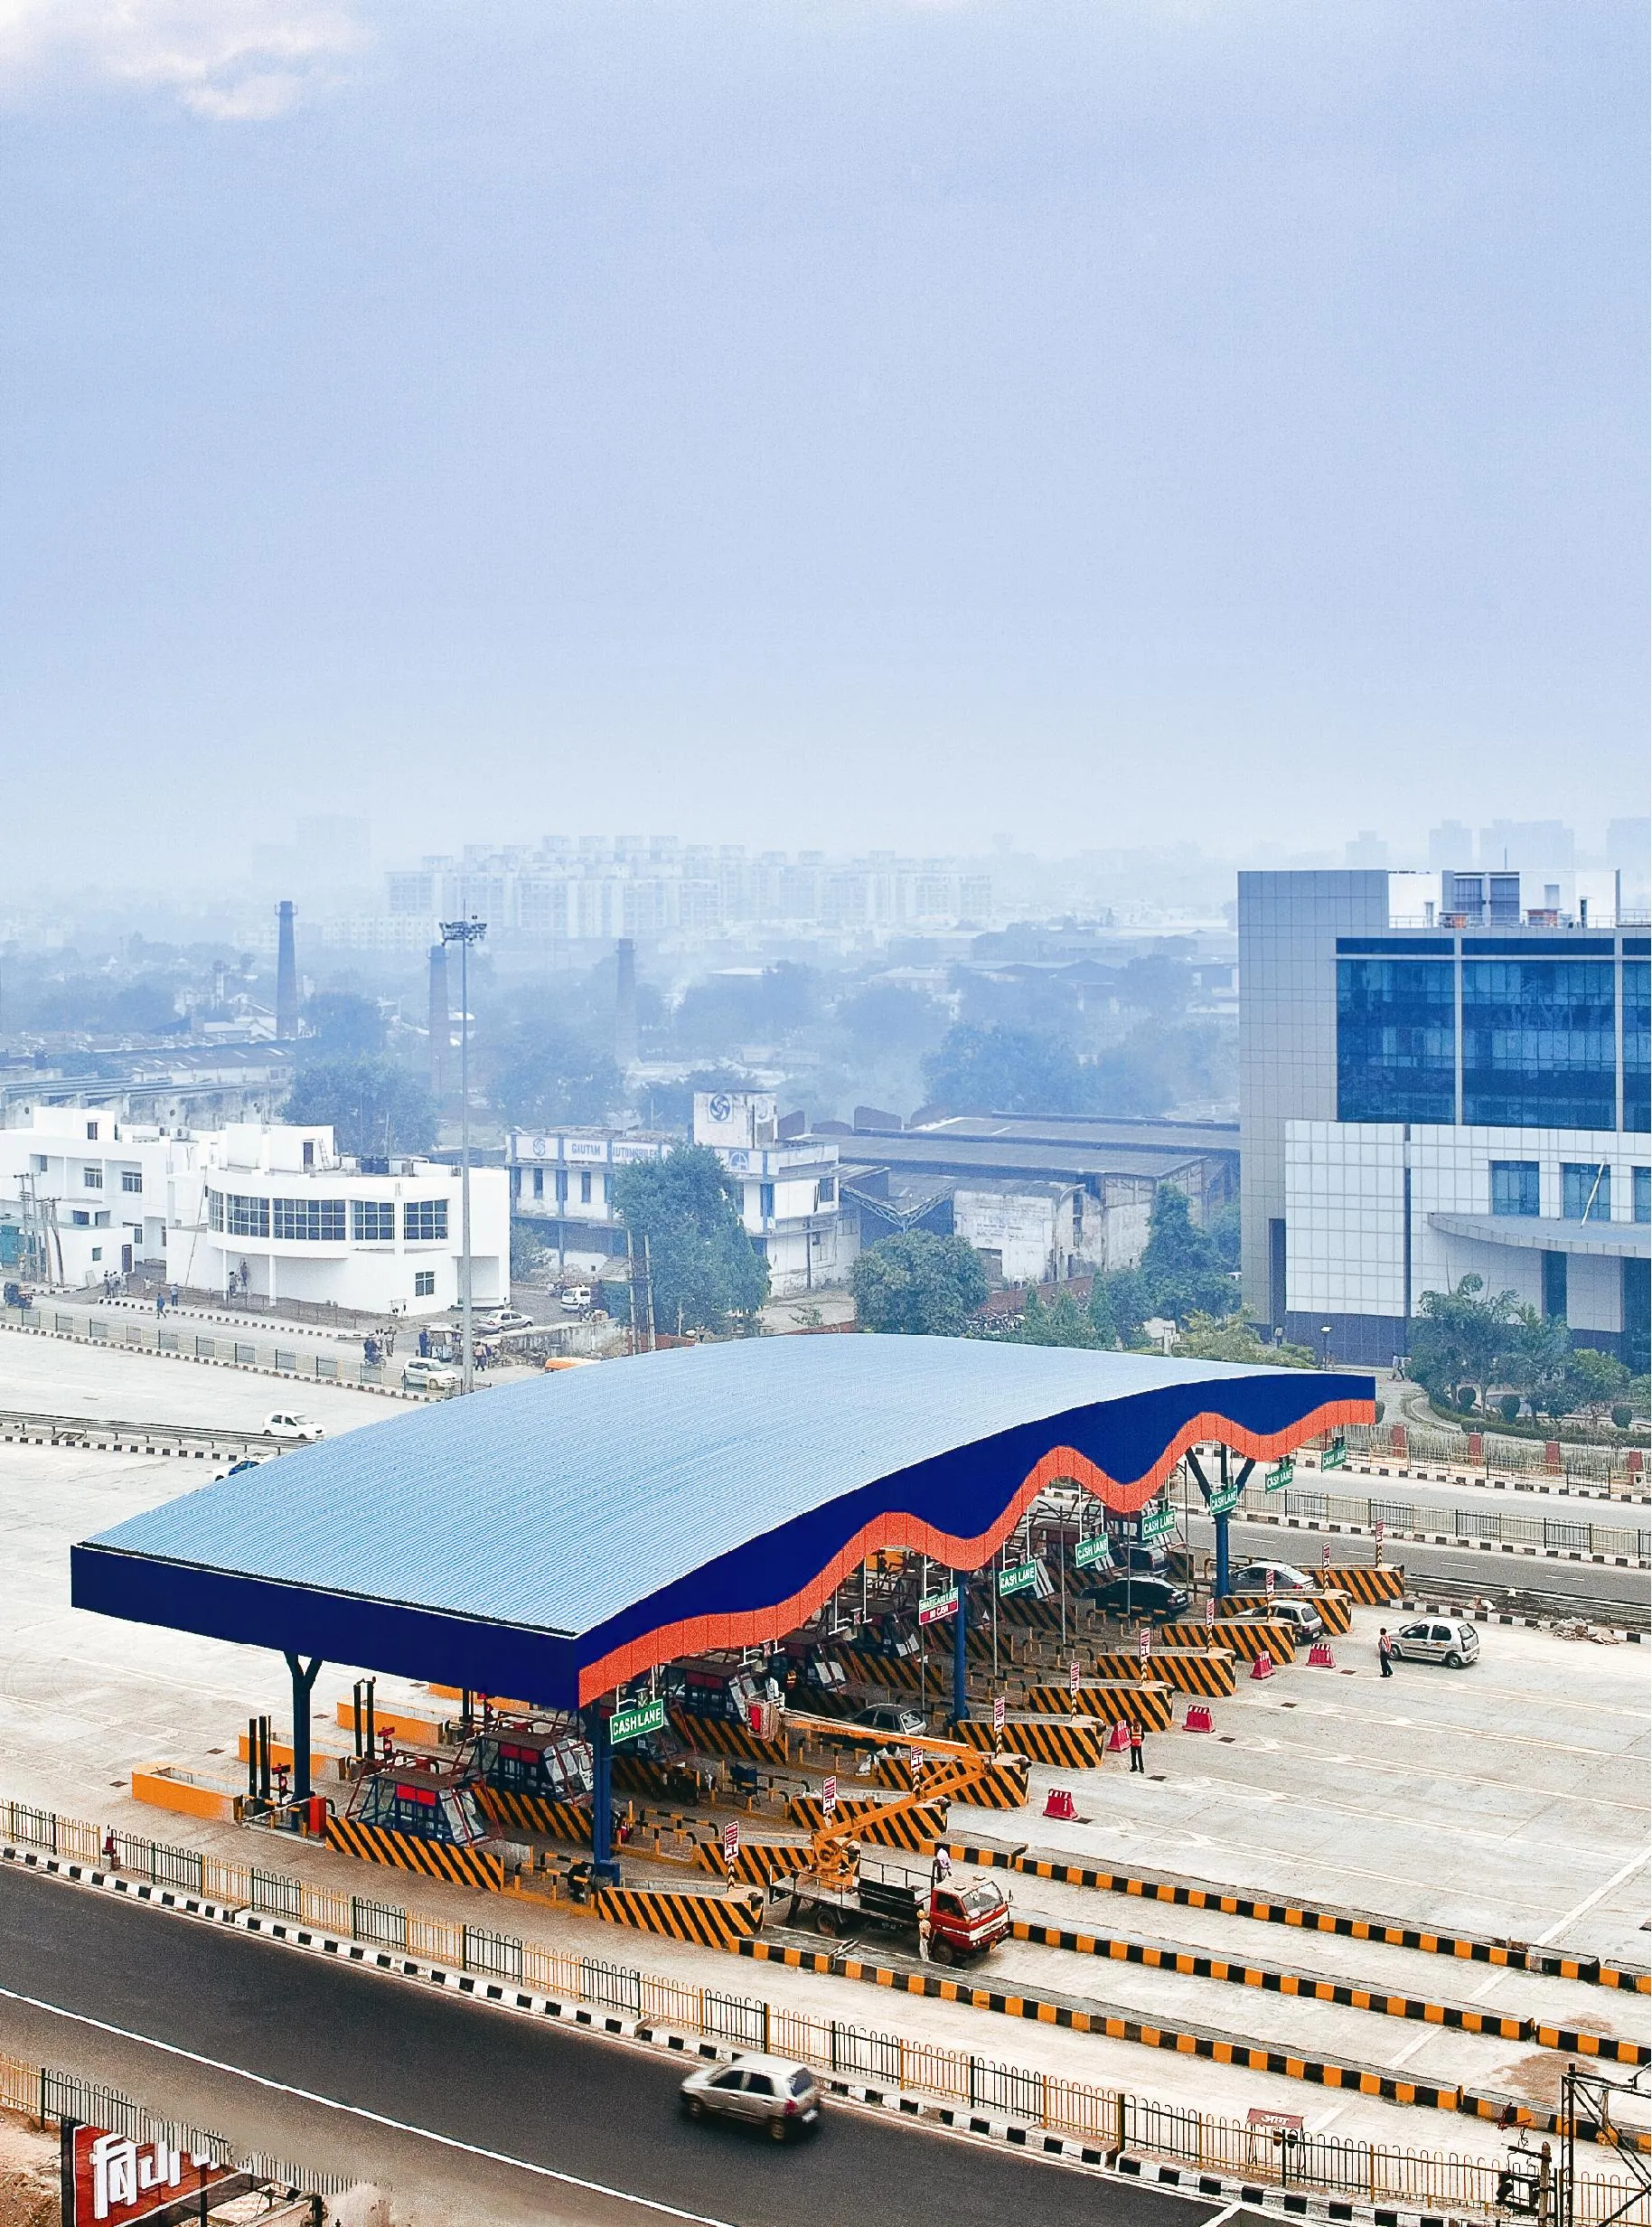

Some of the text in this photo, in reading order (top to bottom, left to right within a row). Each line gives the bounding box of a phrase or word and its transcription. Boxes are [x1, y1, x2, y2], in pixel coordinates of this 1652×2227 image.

[571, 1142, 601, 1156] GAUTAM
[1323, 1450, 1347, 1466] CASH LANE
[1267, 1471, 1293, 1489] CASH LANE
[1211, 1491, 1236, 1511] CASH LANE
[1143, 1513, 1175, 1535] CASH LANE
[1077, 1540, 1108, 1561] CASH LANE
[1000, 1566, 1035, 1589] CASH LANE
[613, 1707, 661, 1735] CASH LANE
